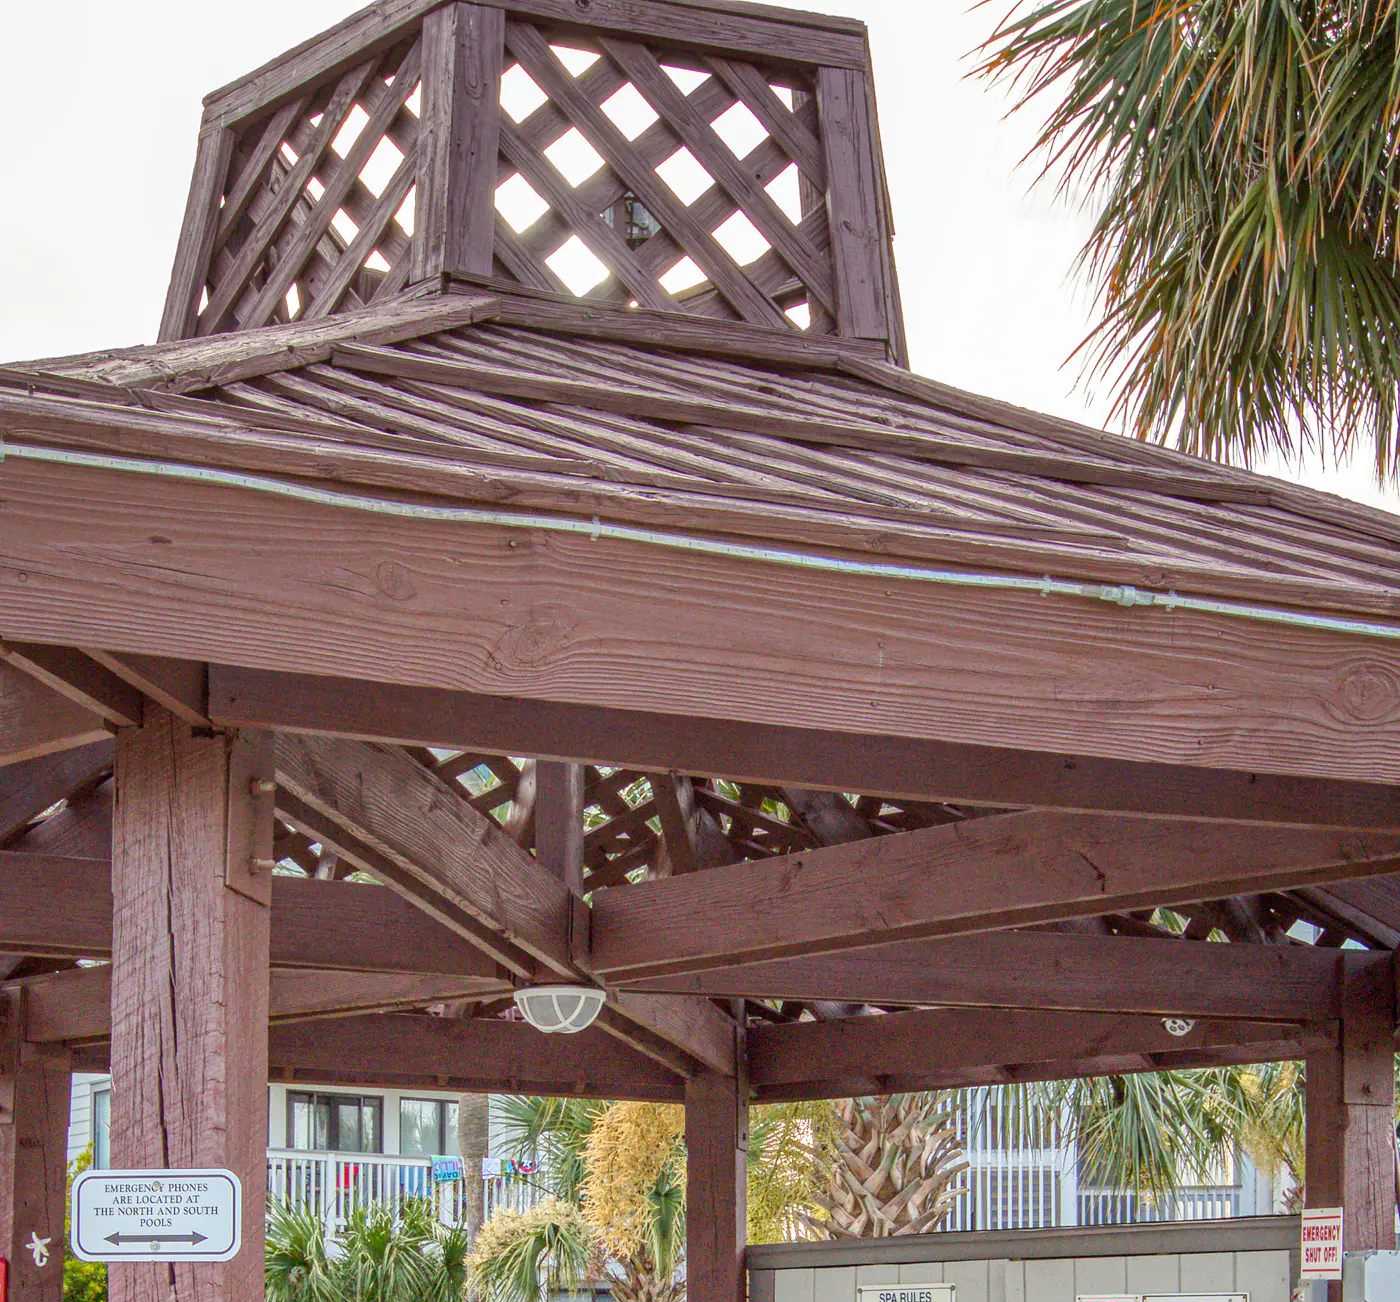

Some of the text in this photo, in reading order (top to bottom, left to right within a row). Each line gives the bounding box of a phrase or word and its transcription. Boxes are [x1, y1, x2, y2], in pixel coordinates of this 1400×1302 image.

[104, 1183, 209, 1193] EMERGENCY PHONES
[112, 1195, 201, 1205] ARE LOCATED AT
[93, 1206, 219, 1216] THE NORTH AND SOUTH
[140, 1218, 173, 1227] POOLS
[1303, 1225, 1341, 1241] EMERGENCY
[1305, 1247, 1338, 1263] SHUT OFF!
